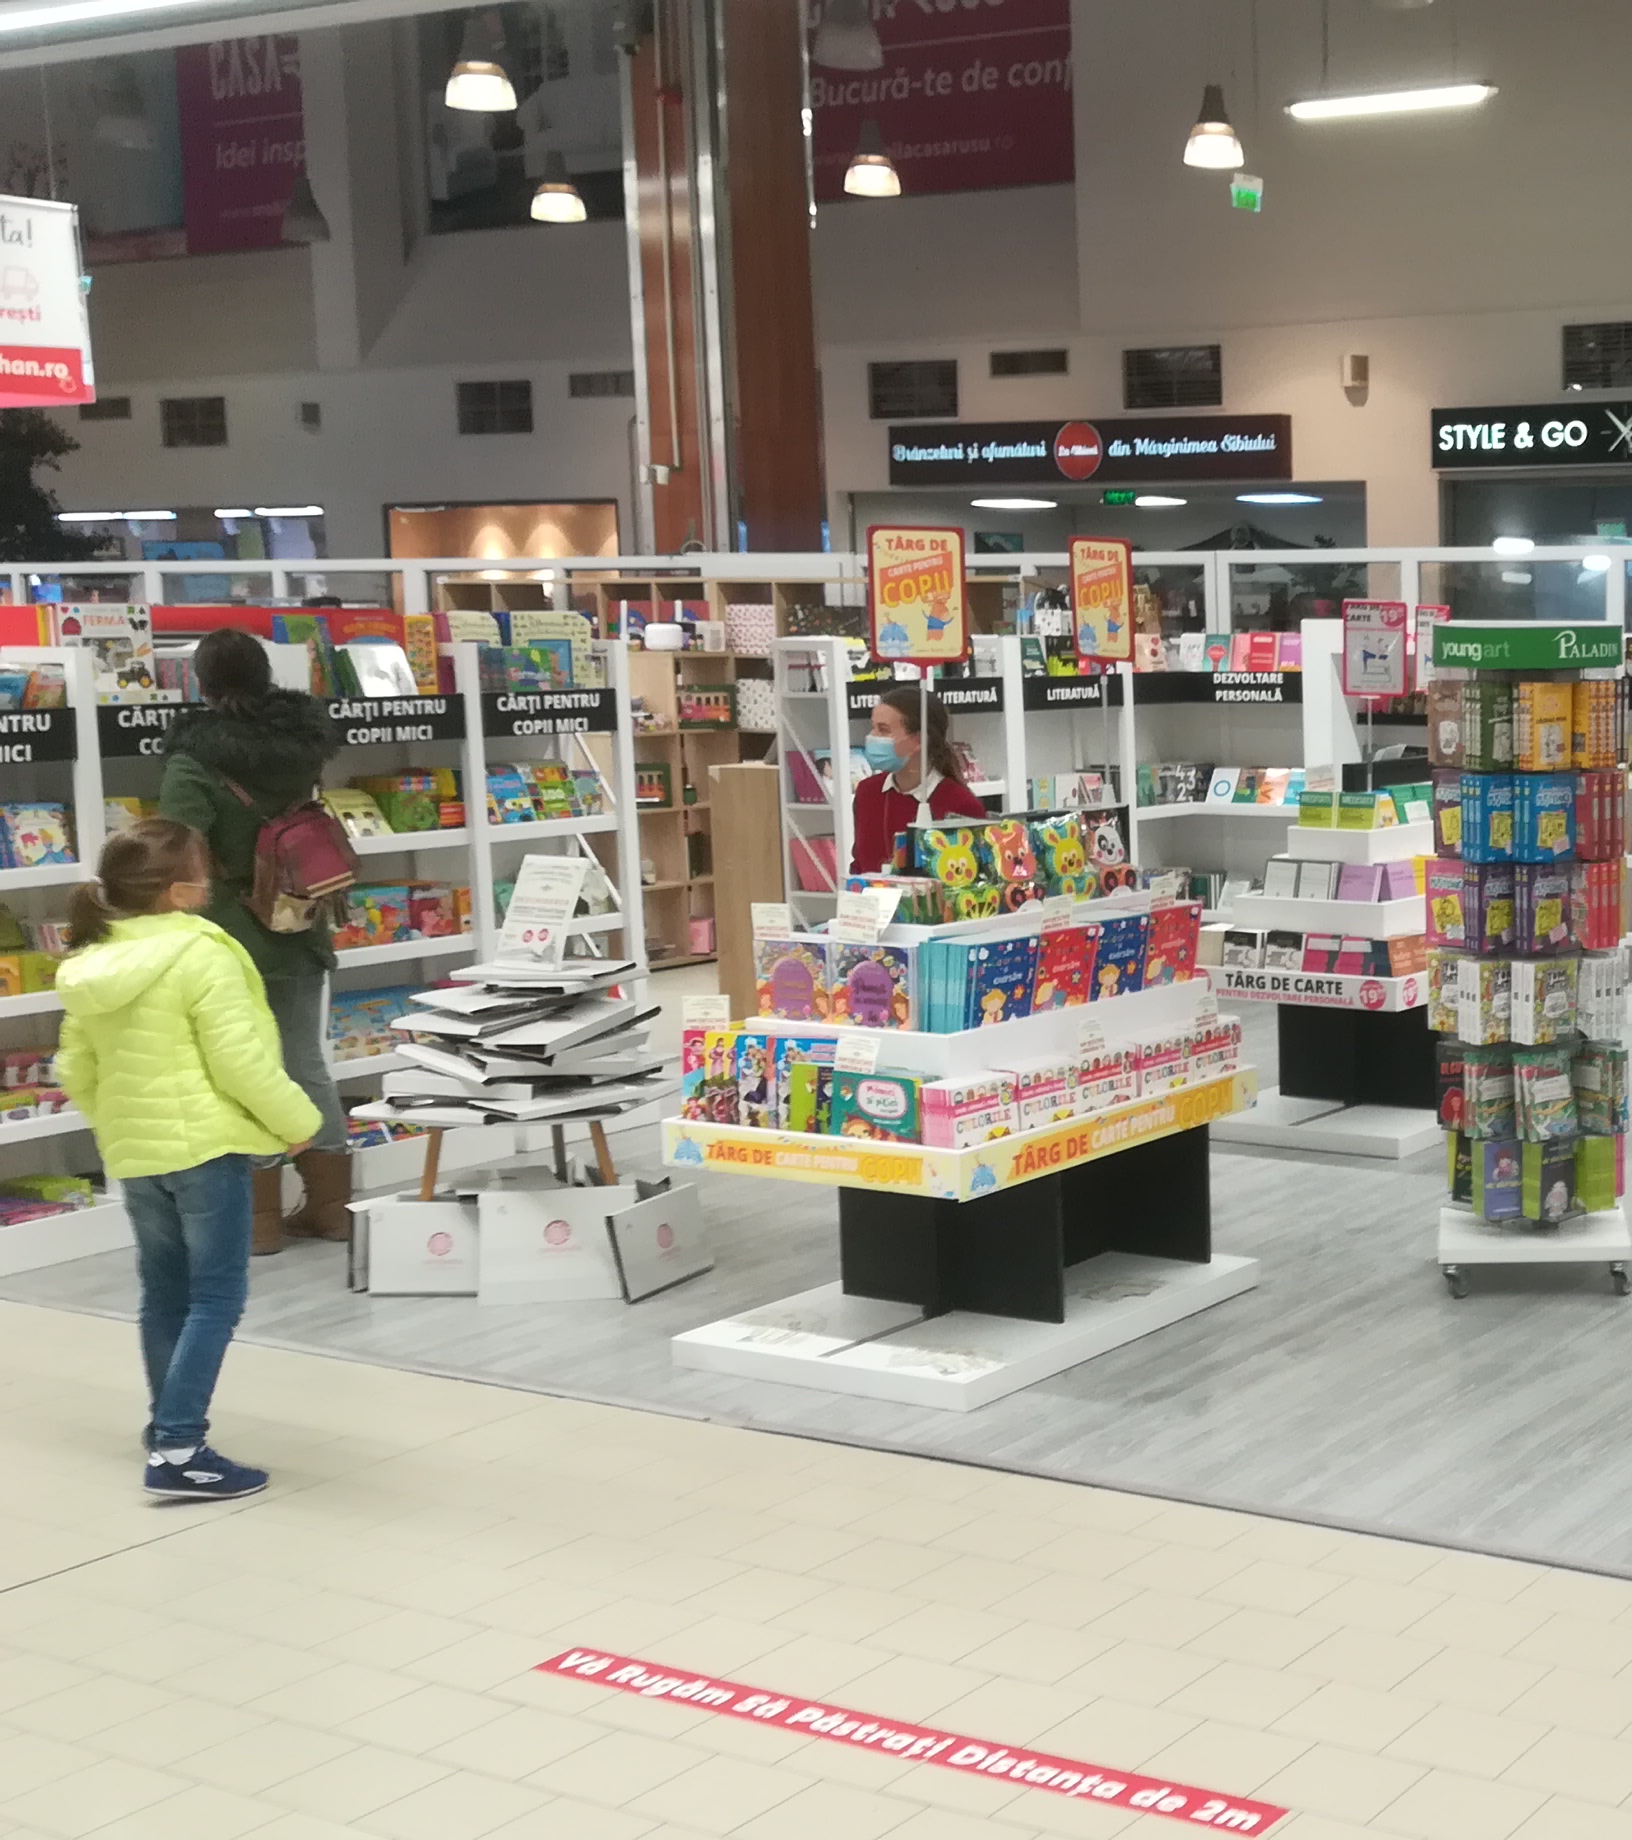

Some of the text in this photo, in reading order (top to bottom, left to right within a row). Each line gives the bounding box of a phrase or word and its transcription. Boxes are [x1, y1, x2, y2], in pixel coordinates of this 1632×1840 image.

[810, 68, 952, 108] Bucură-te
[962, 60, 998, 92] de
[216, 139, 255, 170] Idei
[1108, 439, 1131, 457] din
[1221, 433, 1278, 453] Sibiului
[1438, 420, 1588, 451] STYLE & GO
[886, 536, 948, 551] TÂRG DE
[883, 569, 951, 608] COPII
[1081, 580, 1121, 610] COPII
[1213, 672, 1283, 685] DEZVOLTARE
[497, 693, 600, 714] CĂRȚI PENTRU
[1047, 685, 1100, 700] LITERATURĂ
[1215, 687, 1283, 702] PERSONALĂ
[328, 699, 446, 721] CĂRȚI PENTRU
[347, 725, 433, 745] COPII MICI
[513, 717, 588, 736] COPII MICI
[0, 744, 32, 763] ICI
[1216, 988, 1249, 998] PENTRU
[1225, 971, 1343, 995] TÂRG DE CARTE
[1360, 990, 1378, 1003] 19
[1144, 1062, 1190, 1083] CULORILE
[1082, 1076, 1132, 1099] CULORILE
[1023, 1093, 1077, 1115] CULORILE
[956, 1109, 1011, 1133] CULORILE
[1012, 1142, 1060, 1175] TÂRG
[1067, 1134, 1088, 1159] DE
[1091, 1119, 1128, 1150] CARTE
[1177, 1078, 1233, 1130] COPII
[706, 1140, 748, 1162] TÂRG
[752, 1149, 772, 1165] DE
[860, 1155, 923, 1185] COPII
[557, 1651, 1262, 1831] Vă Rugăm Să Păstrați Distanța de 2m
